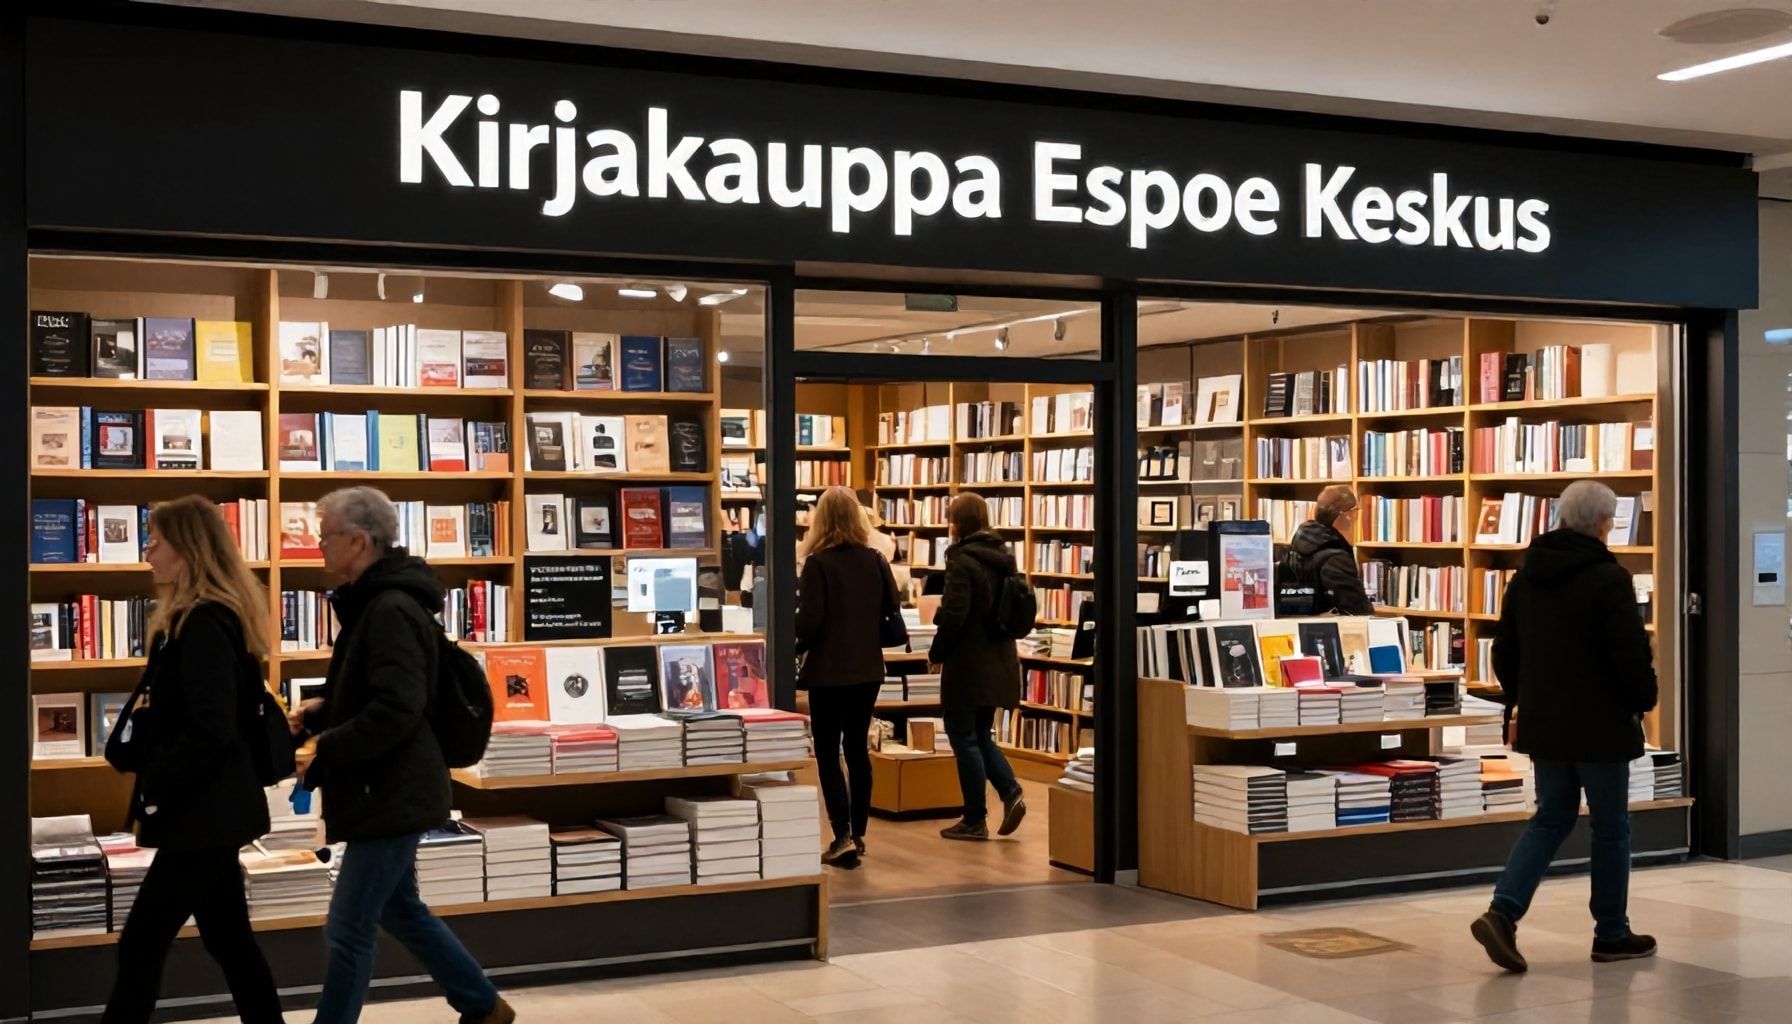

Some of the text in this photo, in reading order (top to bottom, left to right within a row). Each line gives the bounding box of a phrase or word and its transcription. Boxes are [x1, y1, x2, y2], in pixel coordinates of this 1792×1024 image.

[399, 90, 1551, 253] Kirjakauppa Espoe Keskus
